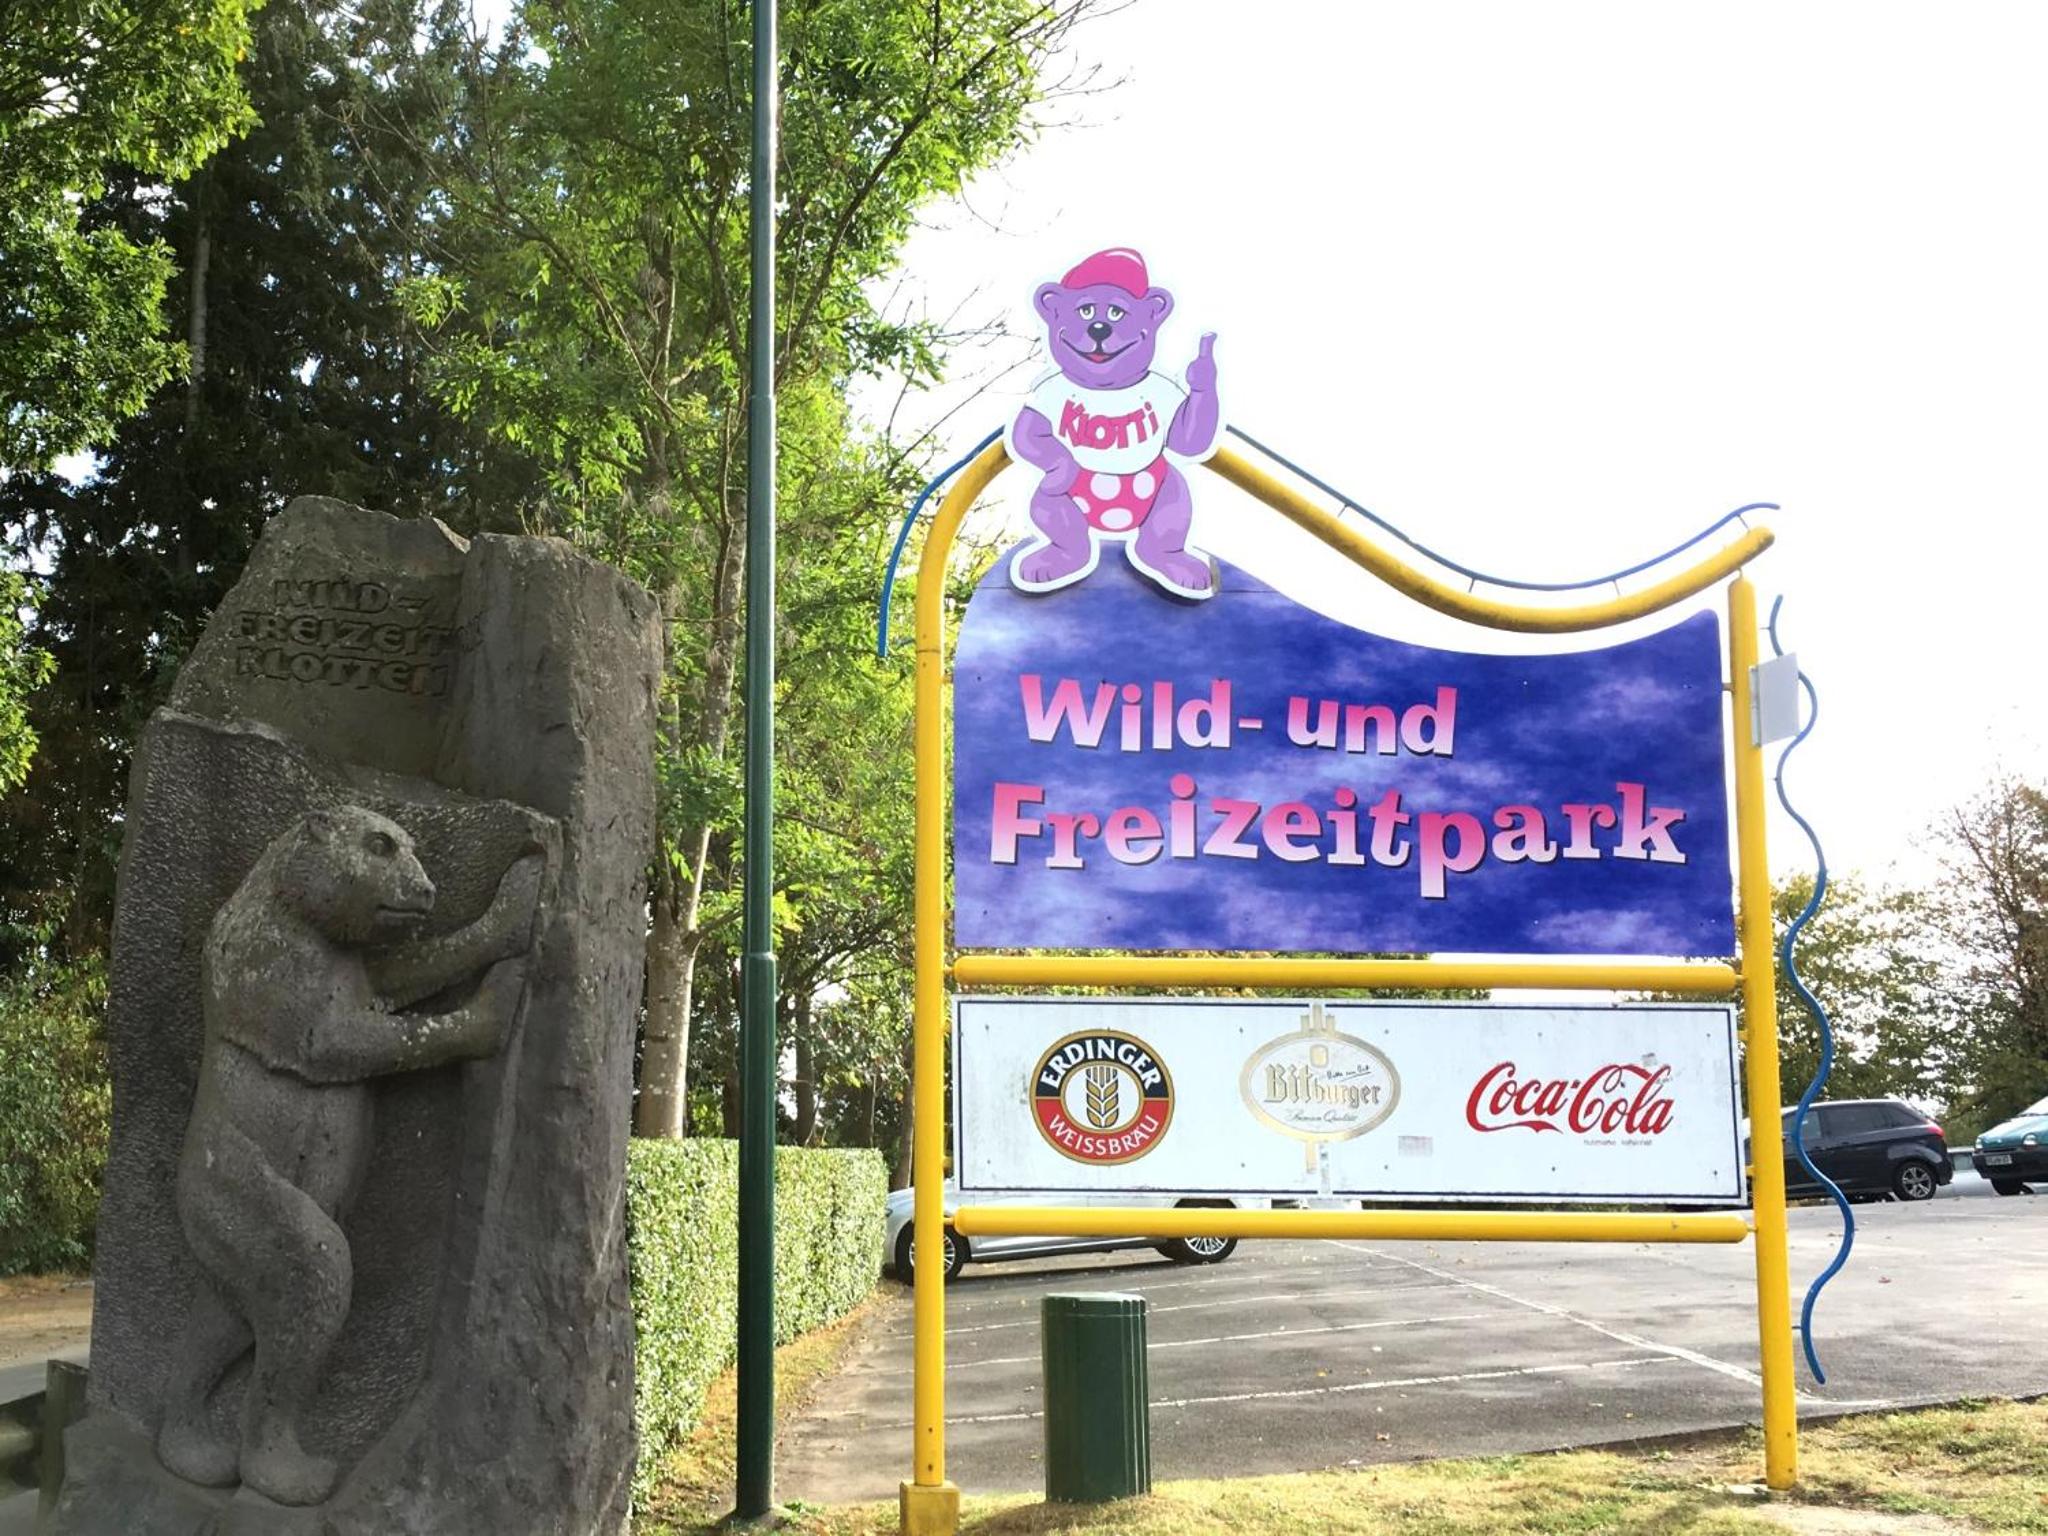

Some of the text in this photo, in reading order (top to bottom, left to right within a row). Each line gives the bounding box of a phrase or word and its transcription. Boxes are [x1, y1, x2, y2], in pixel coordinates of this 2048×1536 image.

[1019, 674, 1458, 757] Wild- und
[989, 774, 1688, 900] Freizeitpark
[1040, 1039, 1161, 1090] ERDINGER
[1263, 1063, 1381, 1109] Bitburger
[1465, 1060, 1675, 1135] Coca-Cola
[1048, 1114, 1160, 1157] WEISSBRÄU
